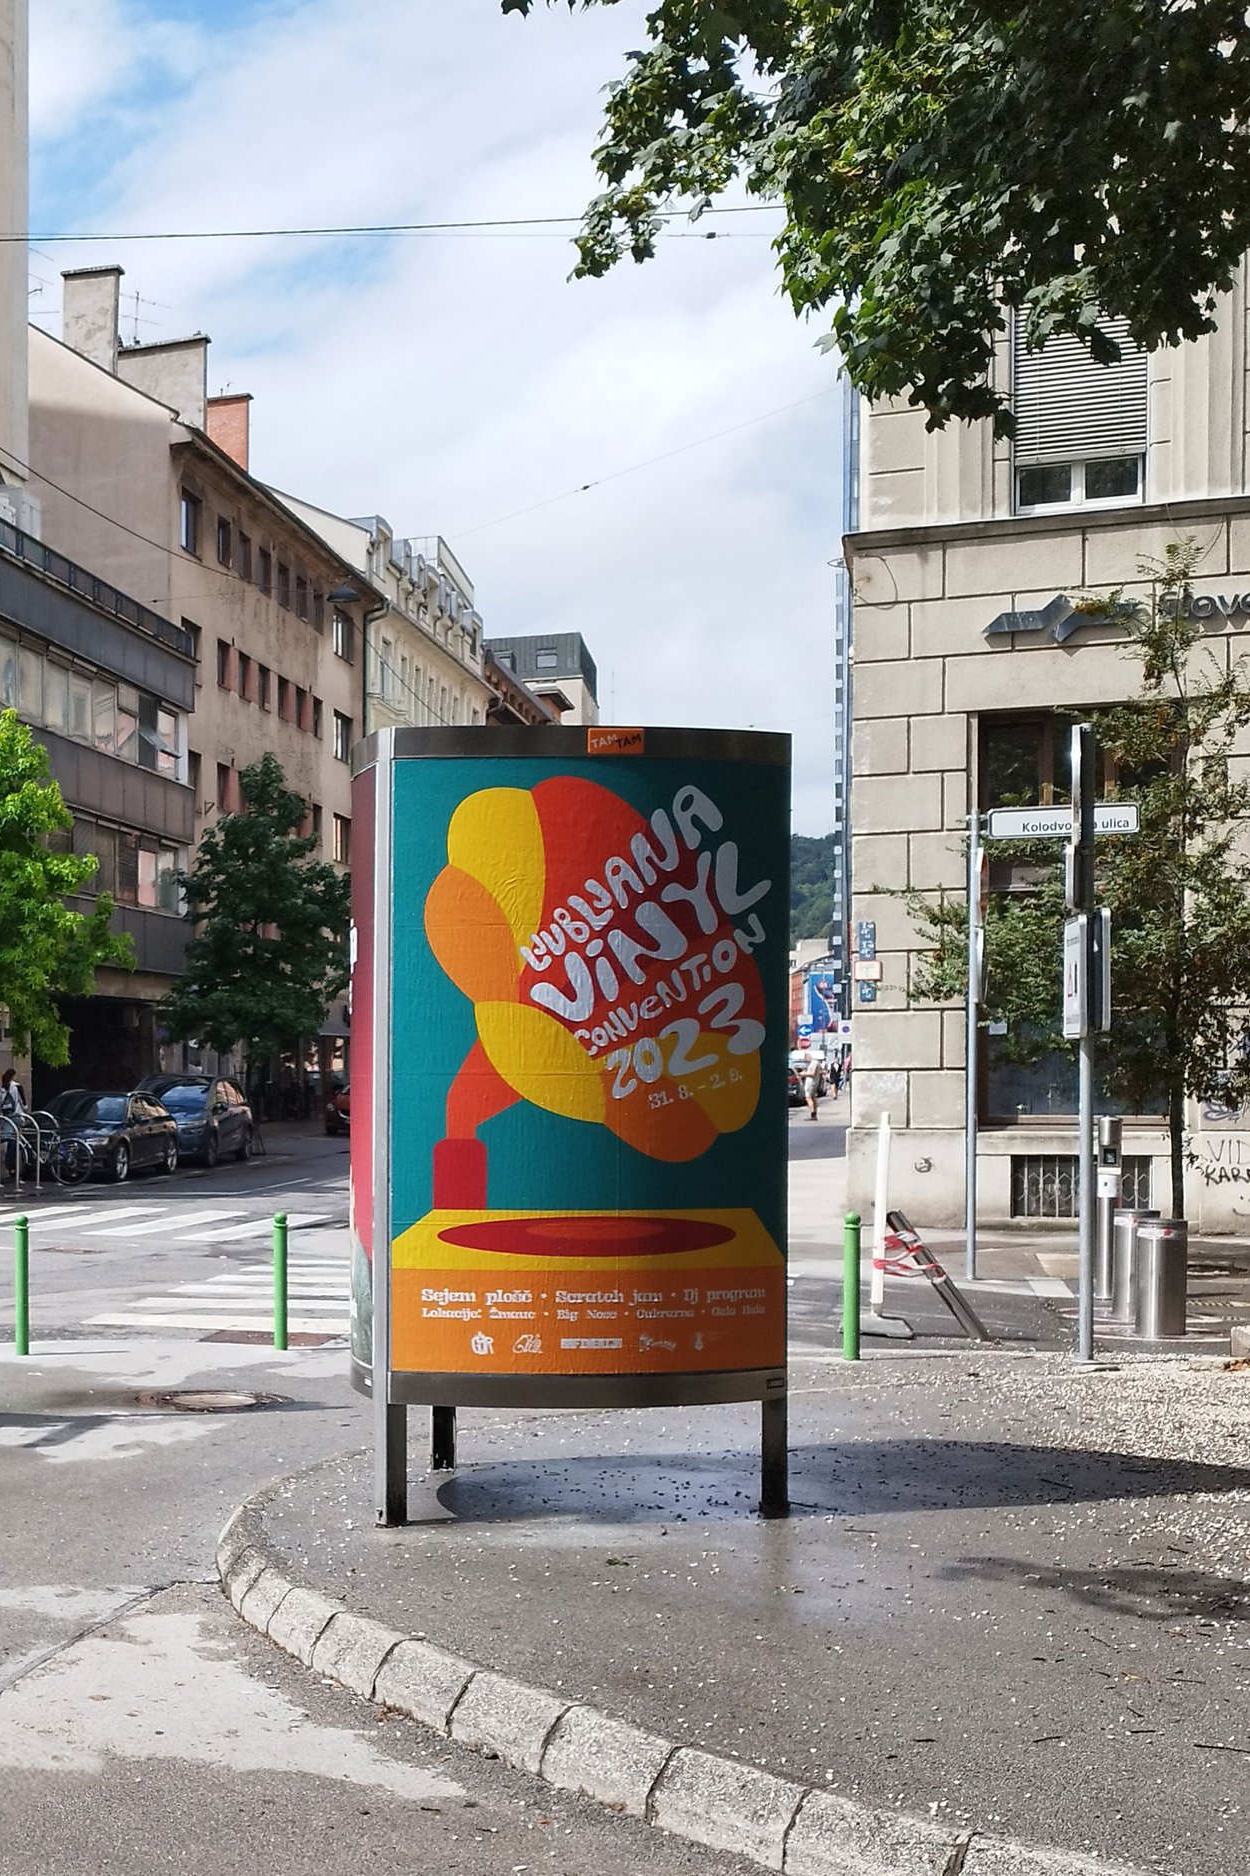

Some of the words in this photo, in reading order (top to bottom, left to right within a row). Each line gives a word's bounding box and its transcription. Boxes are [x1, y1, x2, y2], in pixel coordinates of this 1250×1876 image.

[1159, 591, 1250, 619] Sov
[1021, 820, 1098, 833] Kolodvoa
[1101, 817, 1130, 829] ulica
[519, 785, 724, 972] LJUBLJANA
[604, 983, 766, 1099] 2023
[649, 1091, 674, 1110] 31.
[678, 1084, 694, 1100] 8.
[710, 1074, 725, 1089] 2.
[728, 1067, 743, 1082] 9.
[421, 1287, 477, 1306] Sejem
[485, 1288, 533, 1306] plošč
[555, 1289, 624, 1304] Scratch
[629, 1289, 663, 1306] jam
[684, 1287, 699, 1304] Dj
[706, 1287, 766, 1304] program
[421, 1307, 482, 1321] Lokacije:
[556, 1309, 579, 1321] Big
